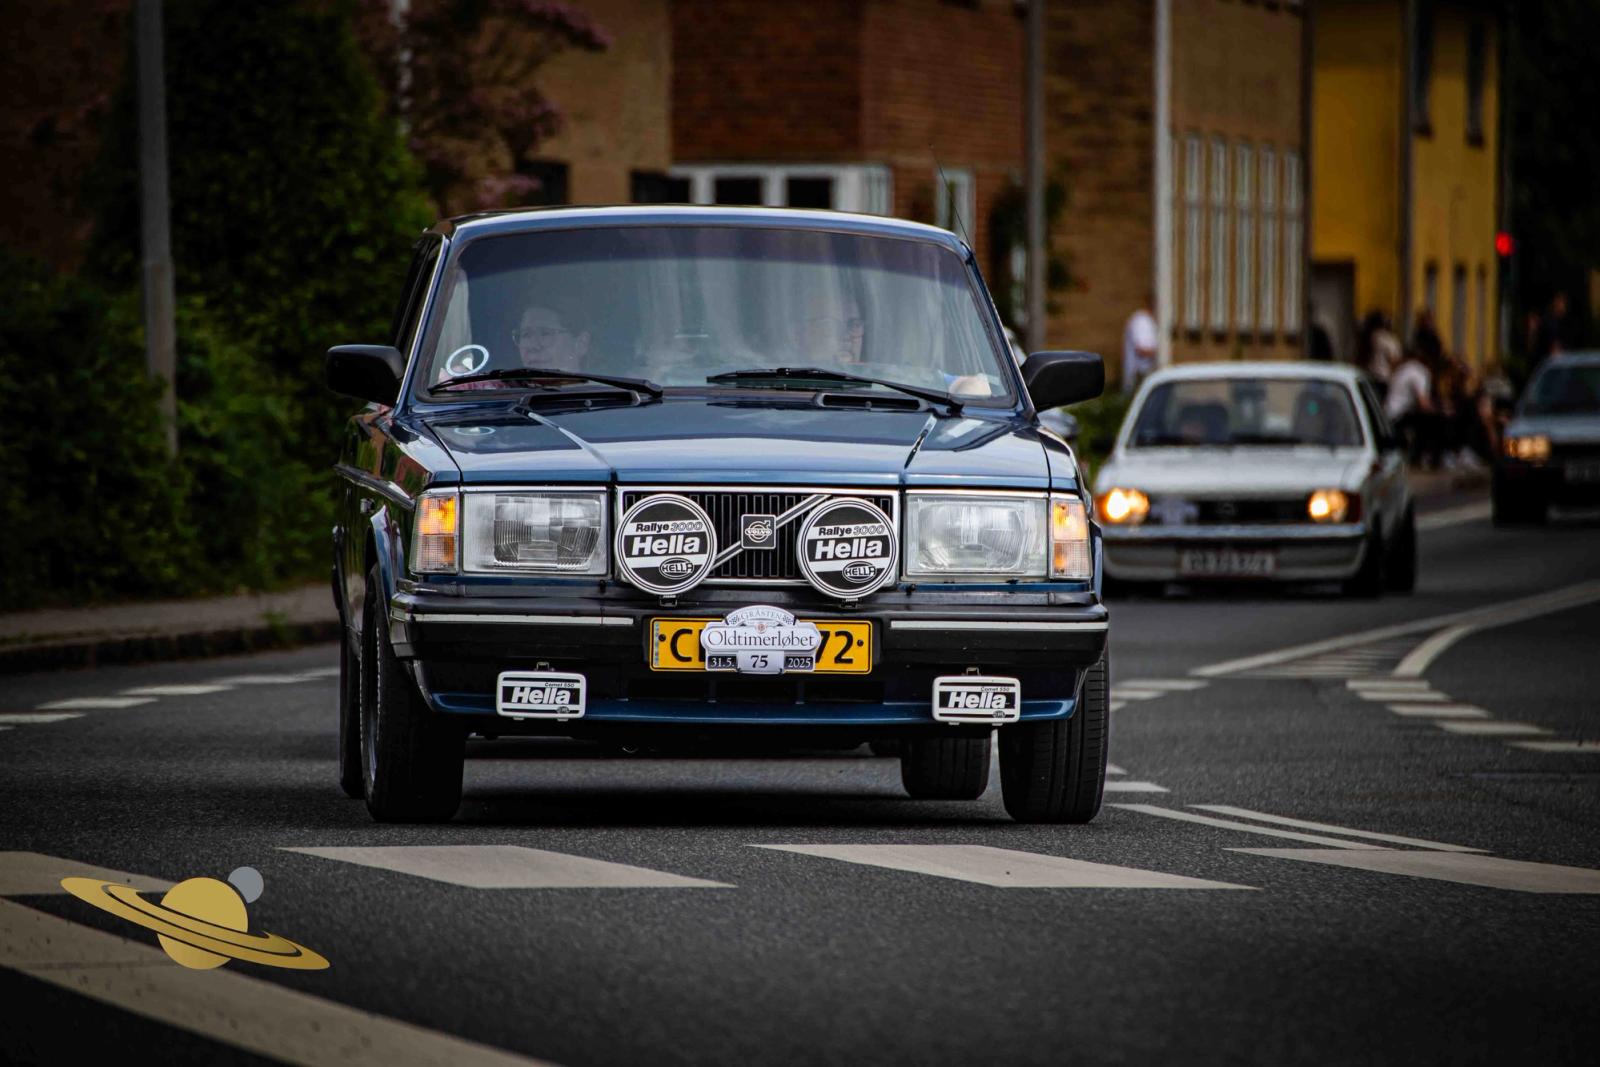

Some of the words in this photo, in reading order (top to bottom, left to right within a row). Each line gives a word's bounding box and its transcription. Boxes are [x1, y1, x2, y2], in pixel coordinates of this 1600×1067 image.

[635, 522, 670, 533] Rallye
[670, 521, 703, 532] 3000
[818, 526, 851, 537] Rallye
[852, 525, 885, 535] 3000
[631, 534, 700, 556] Hella
[814, 538, 883, 560] Hella
[661, 562, 694, 574] HELLA
[844, 566, 877, 576] HELLA
[707, 630, 816, 649] Oldtimerløbet
[750, 655, 768, 669] 75
[787, 657, 811, 668] 2025
[511, 686, 571, 704] Hella
[948, 691, 1006, 709] Hella
